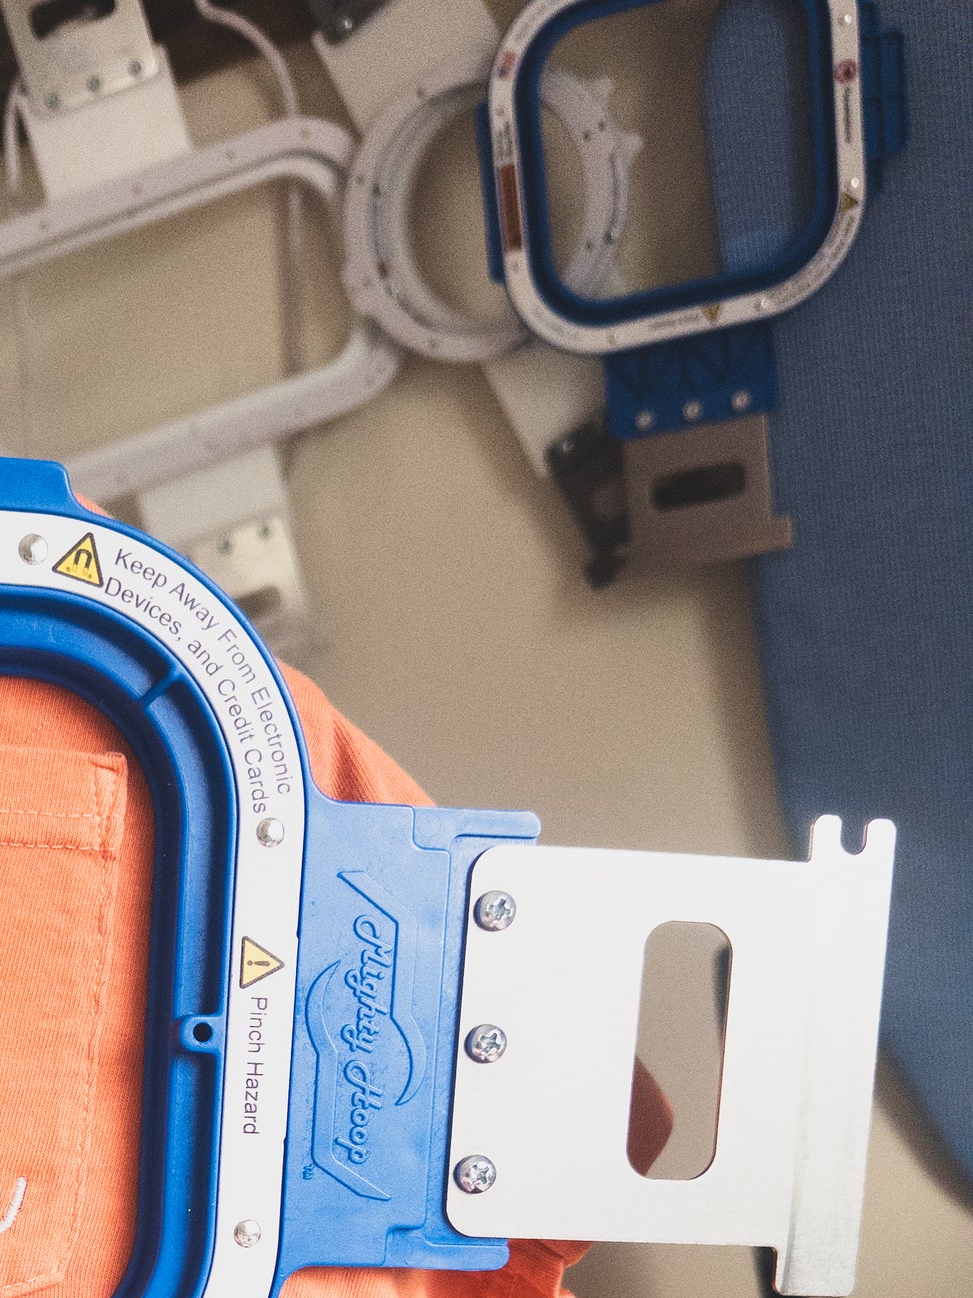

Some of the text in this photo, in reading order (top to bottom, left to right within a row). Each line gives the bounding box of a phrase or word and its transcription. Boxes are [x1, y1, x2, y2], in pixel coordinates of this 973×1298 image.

[103, 575, 270, 814] Devices, and Credit Cards
[113, 547, 292, 796] Keep Away From Electronic
[243, 996, 268, 1135] Pinch Hazard
[334, 914, 393, 1165] Mighty Hoop
